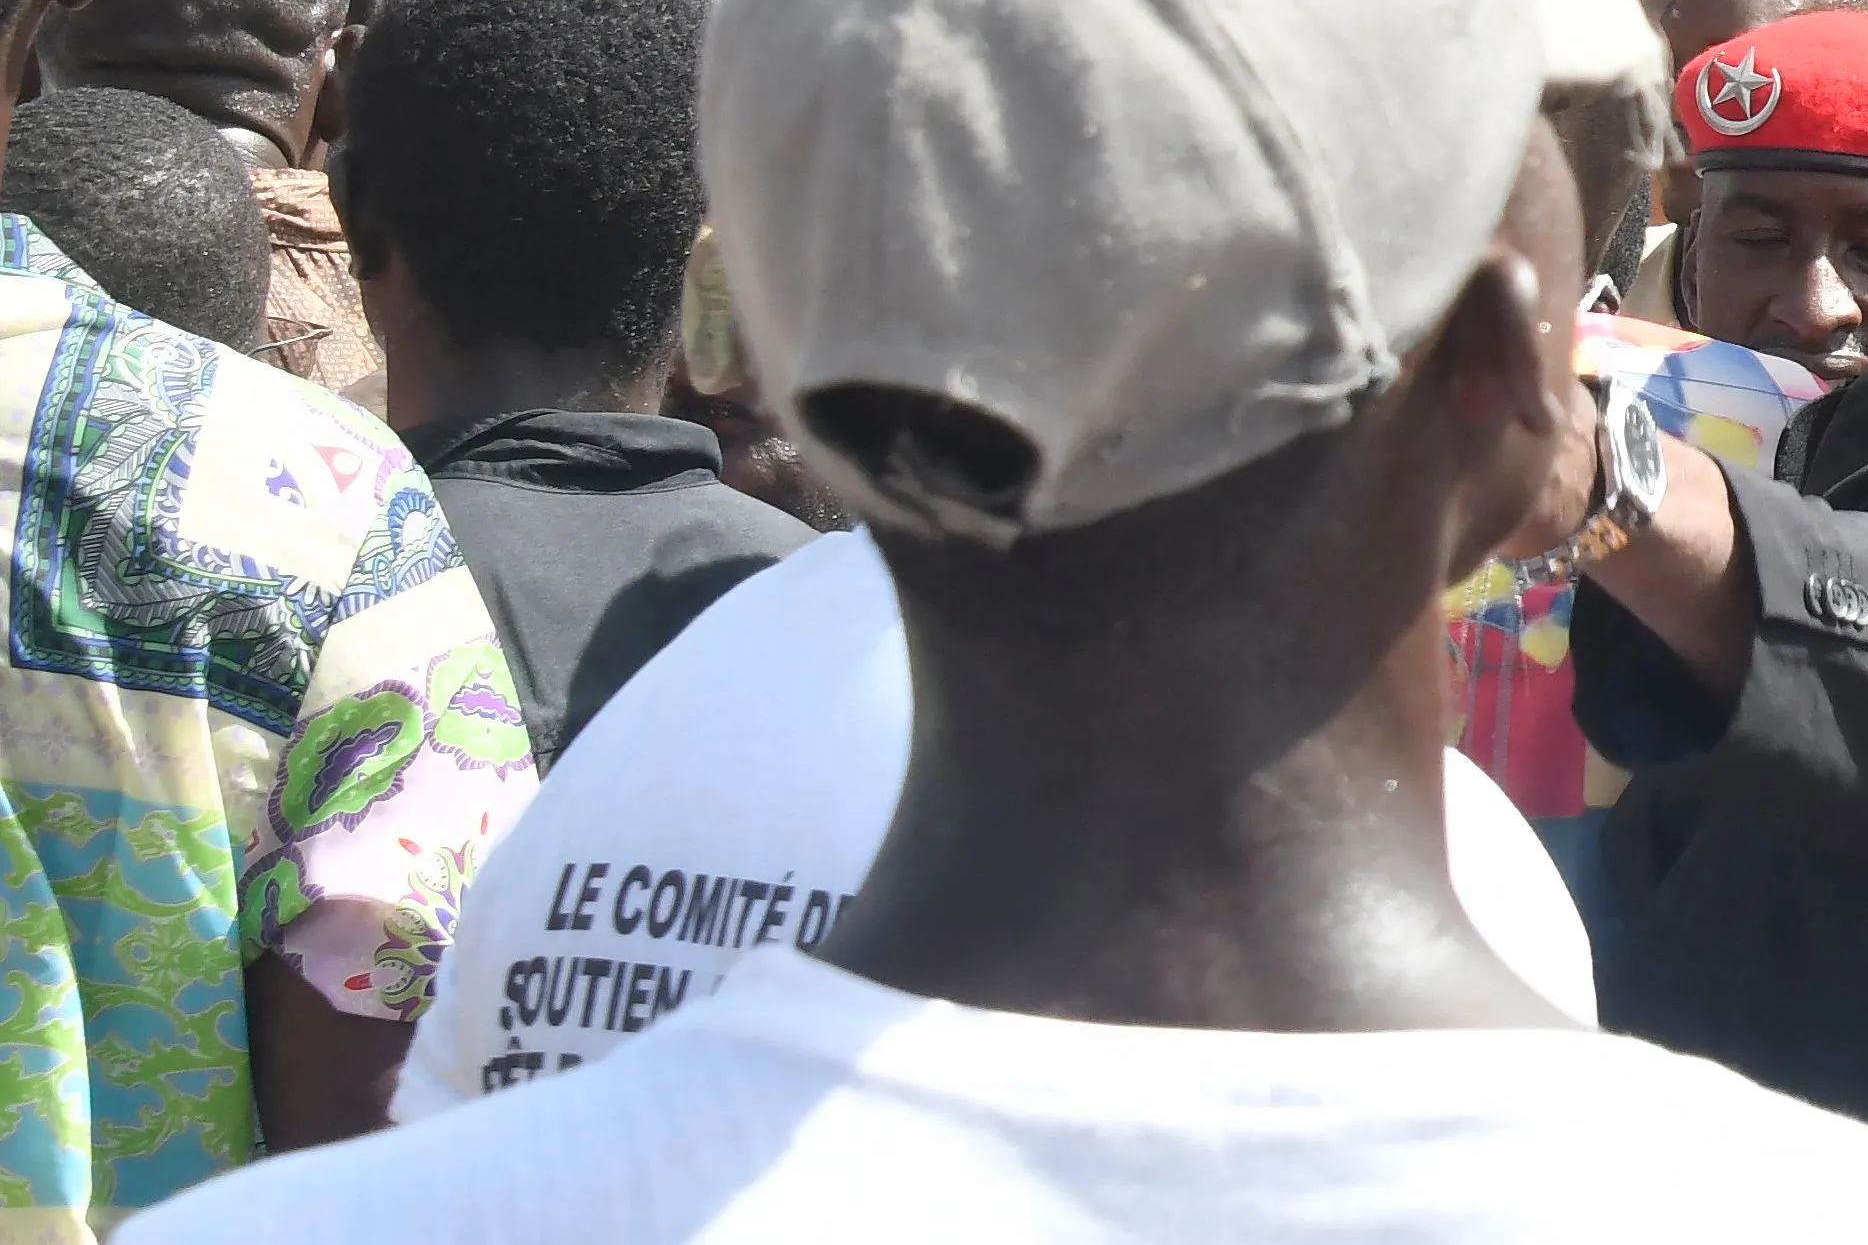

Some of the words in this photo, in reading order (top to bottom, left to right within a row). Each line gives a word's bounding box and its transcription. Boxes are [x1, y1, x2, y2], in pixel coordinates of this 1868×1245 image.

[545, 862, 611, 932] LE
[612, 864, 796, 950] COMITÉ
[498, 955, 693, 1033] SOUTIEN
